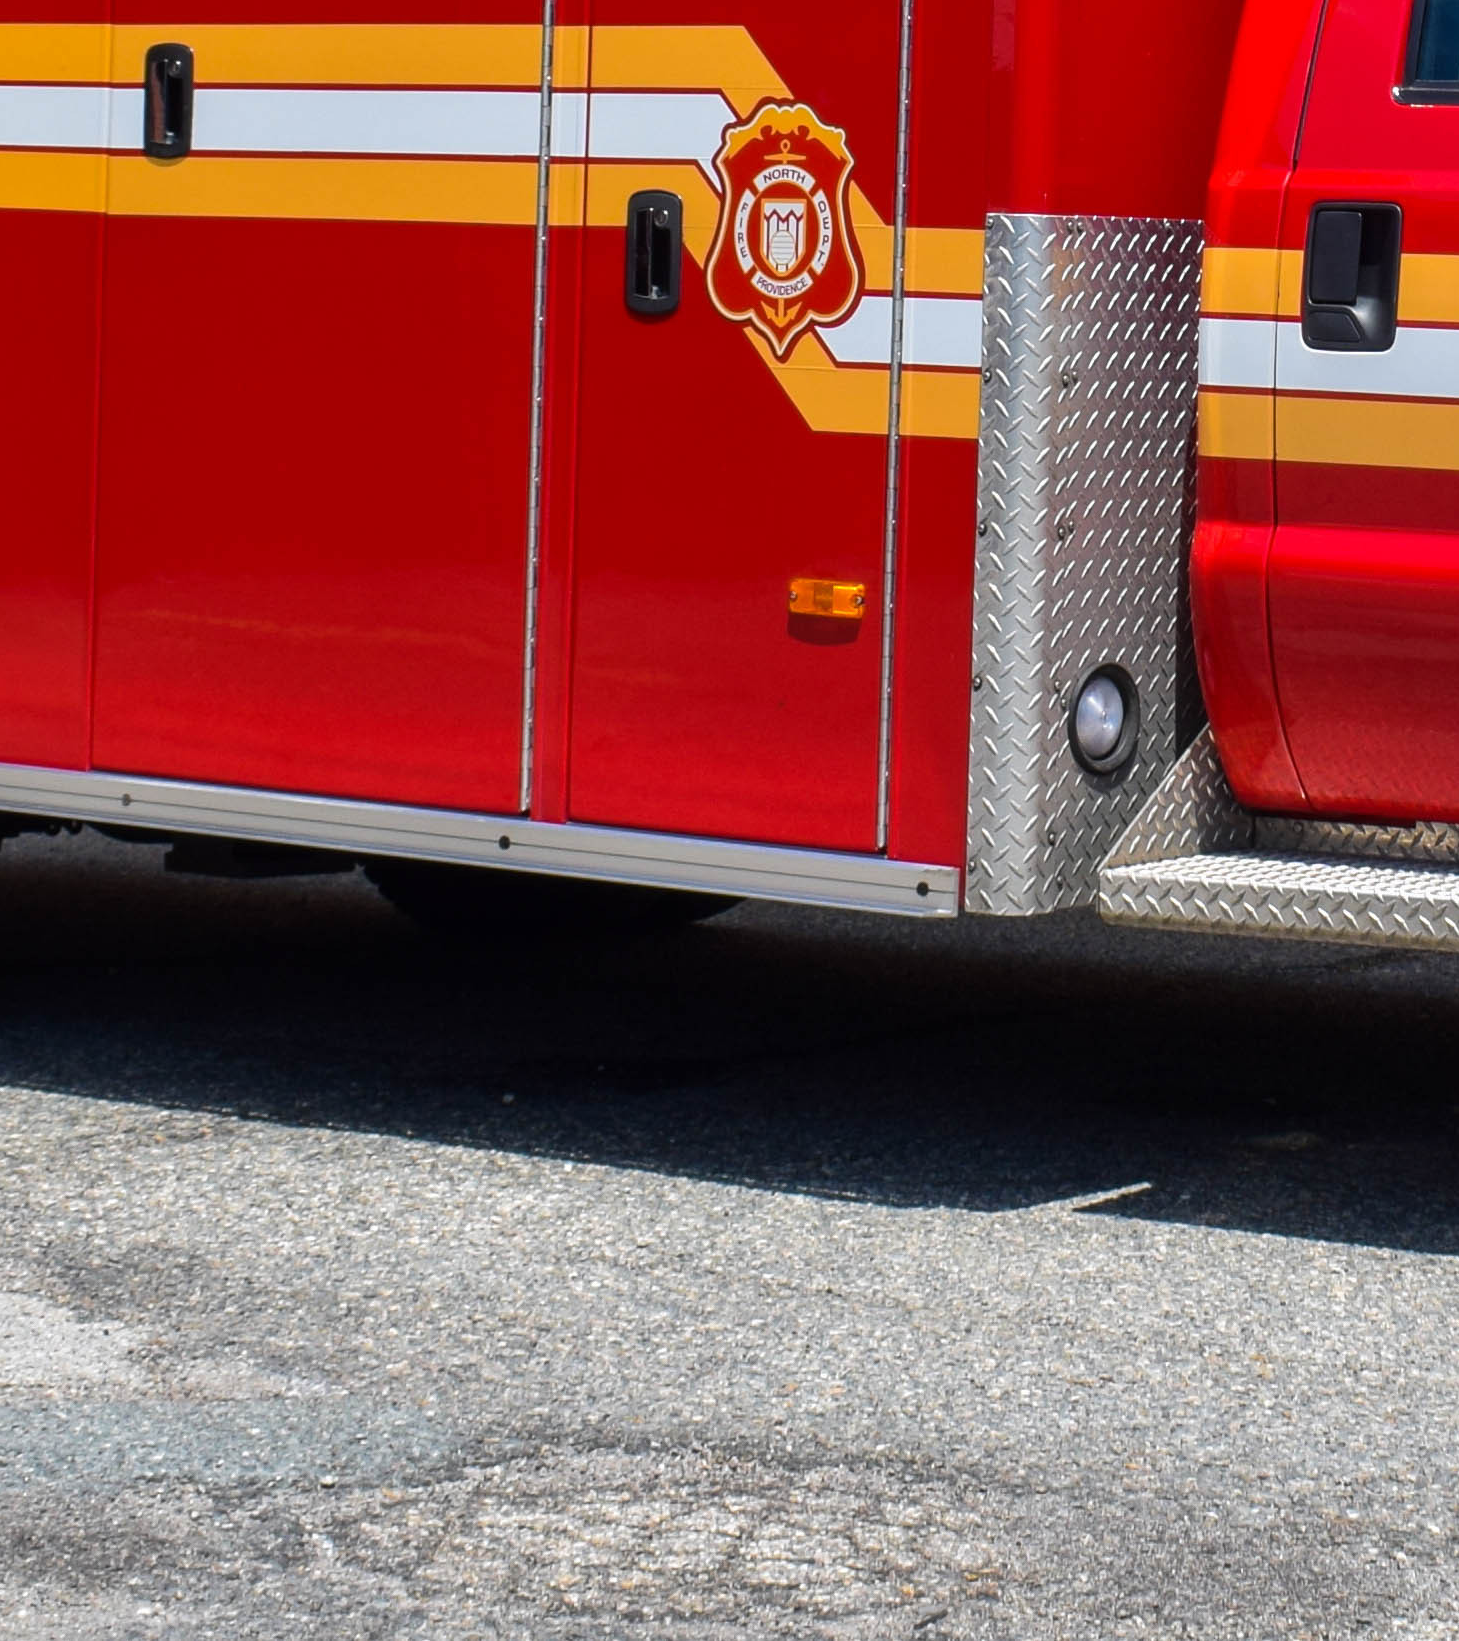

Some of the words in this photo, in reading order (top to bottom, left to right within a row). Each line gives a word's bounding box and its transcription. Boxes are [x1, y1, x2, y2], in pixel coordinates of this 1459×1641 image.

[762, 168, 807, 184] NORTH
[737, 202, 749, 259] FIRE
[756, 275, 809, 296] PROVIDENCE
